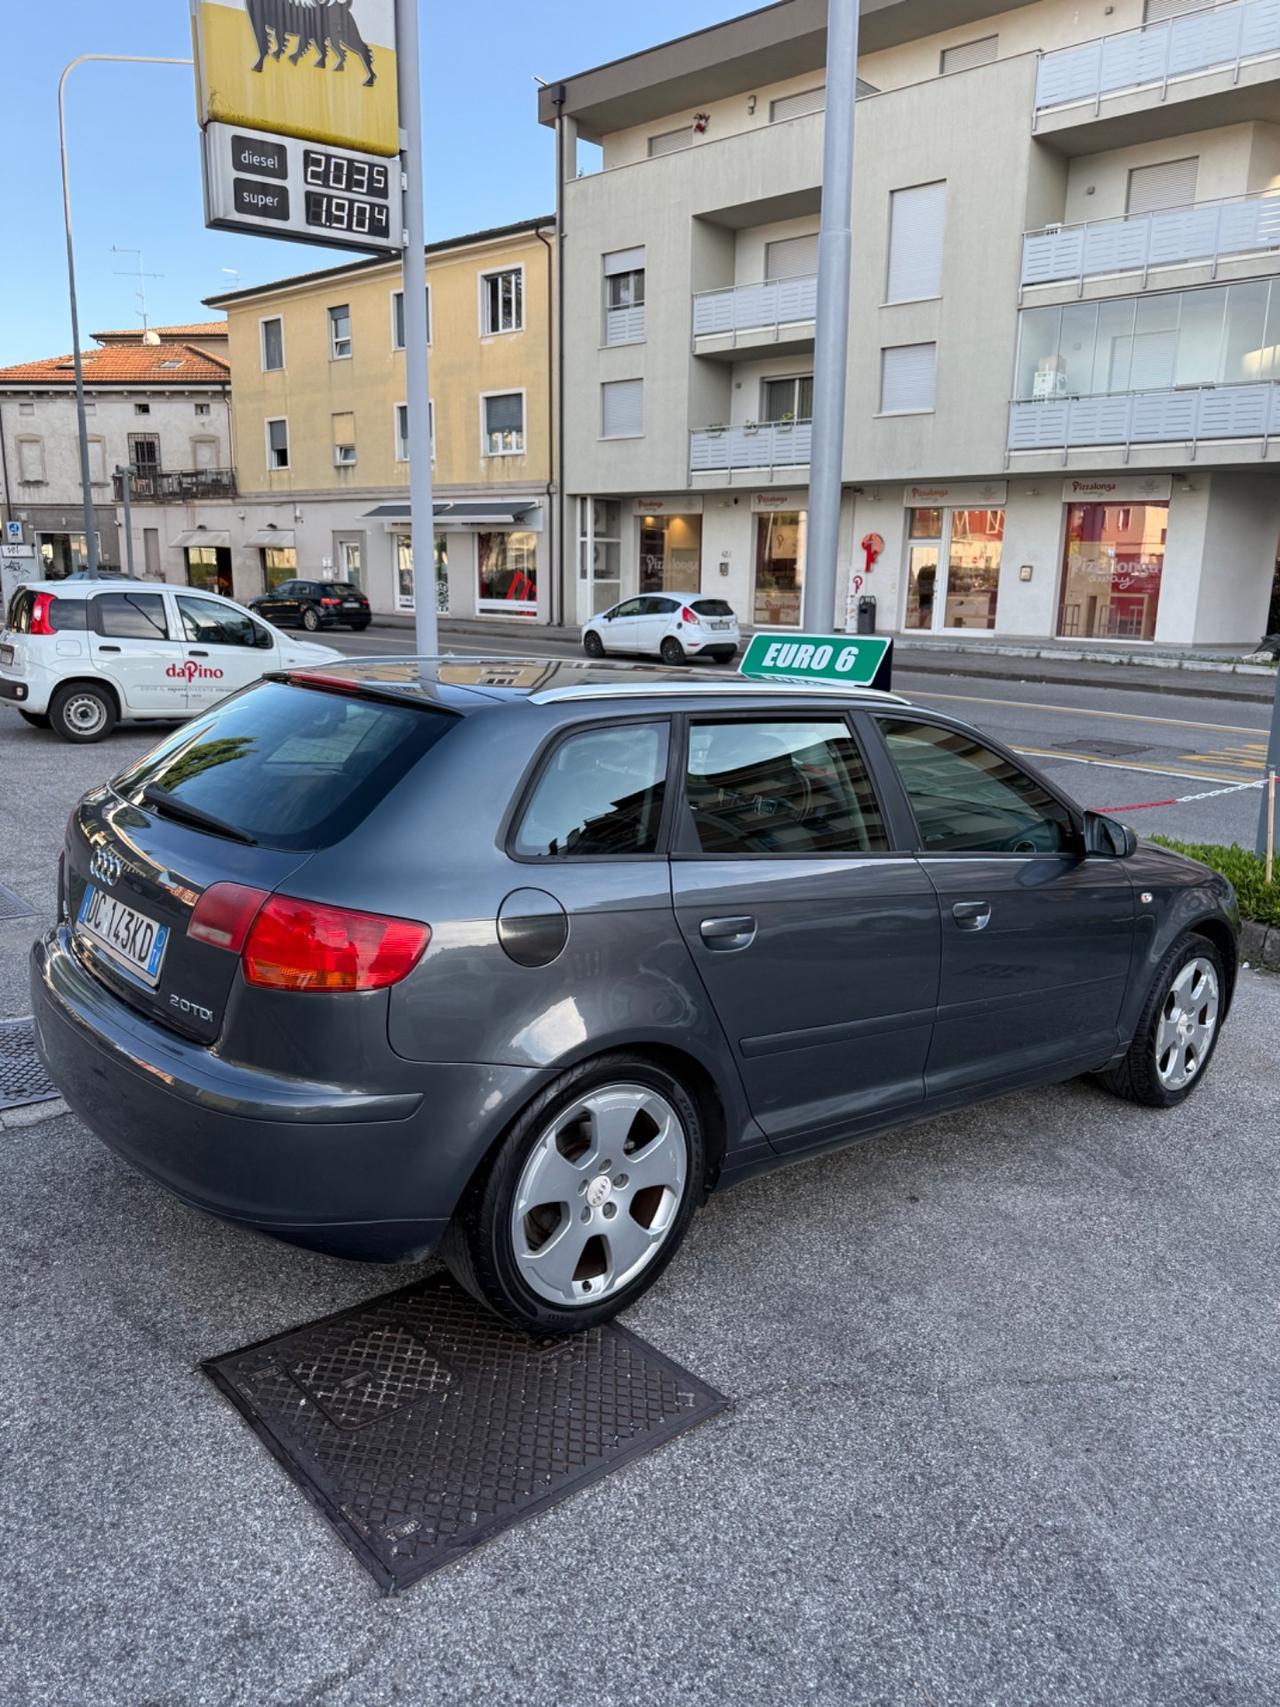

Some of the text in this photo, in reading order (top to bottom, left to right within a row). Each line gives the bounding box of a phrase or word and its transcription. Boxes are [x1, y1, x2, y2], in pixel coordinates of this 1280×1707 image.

[241, 150, 278, 168] diesel
[243, 190, 279, 208] super
[1072, 481, 1115, 493] Pizzalonga
[762, 642, 860, 672] EURO 6
[165, 660, 225, 684] daPino
